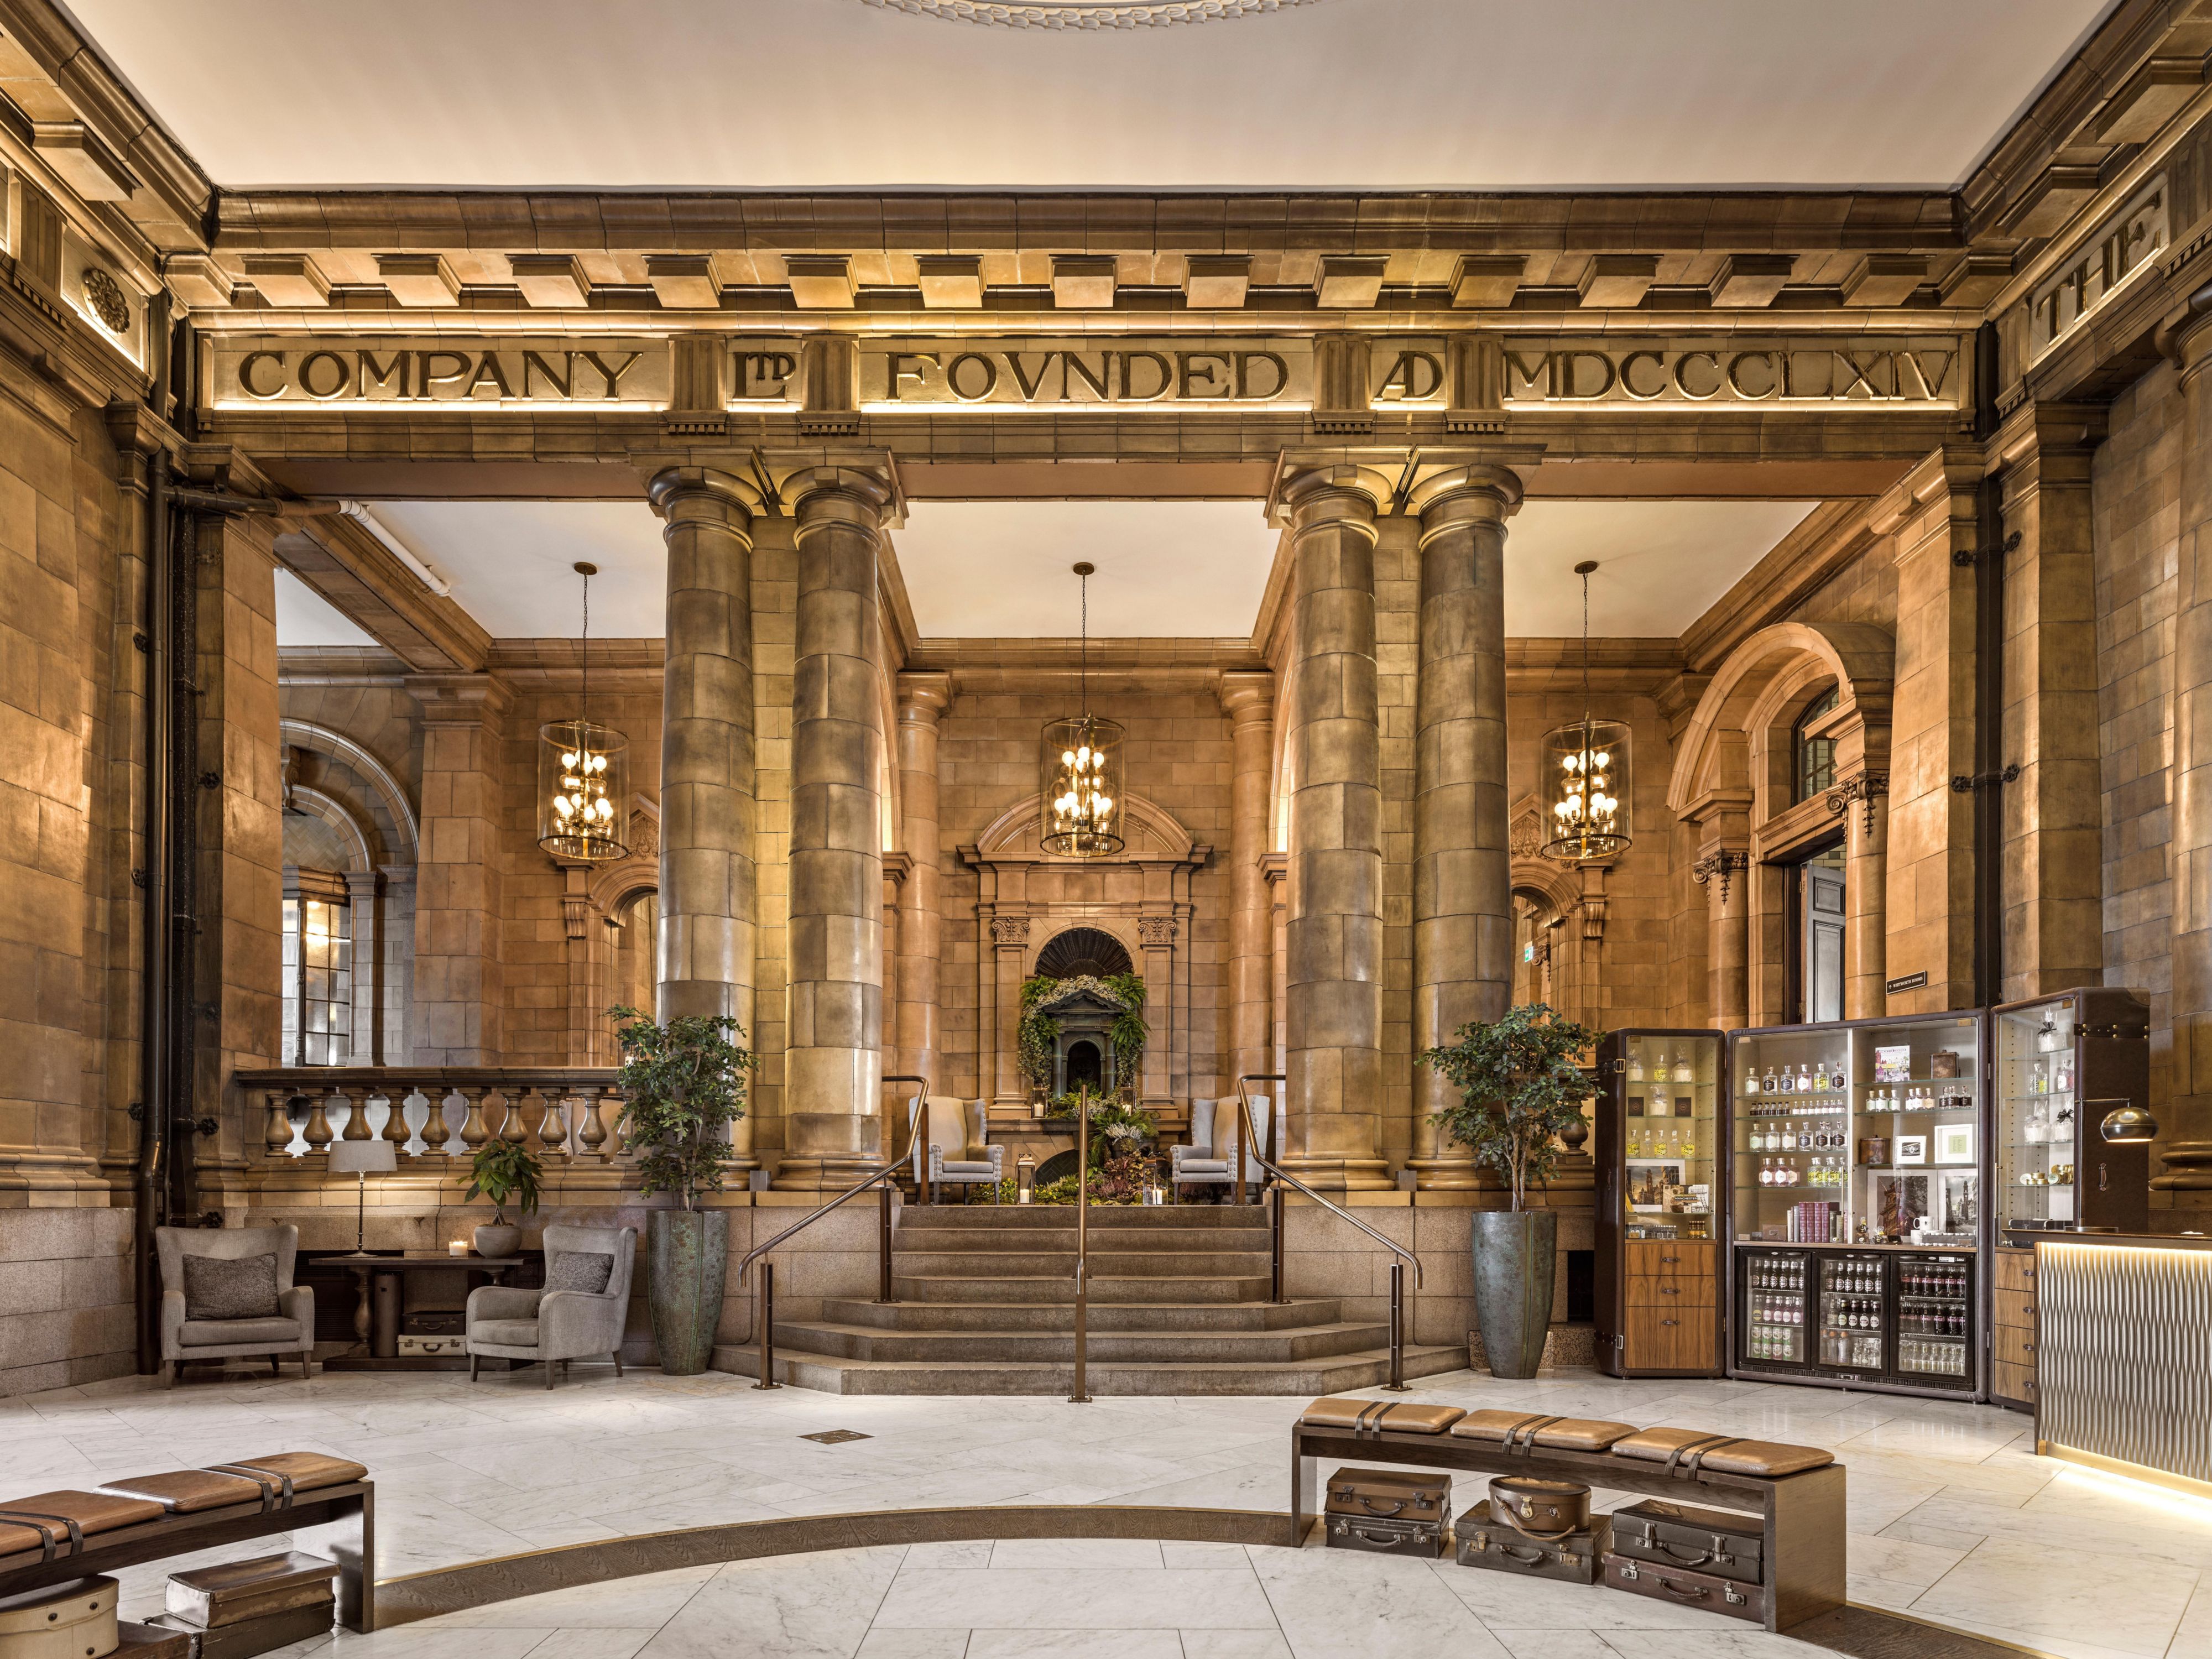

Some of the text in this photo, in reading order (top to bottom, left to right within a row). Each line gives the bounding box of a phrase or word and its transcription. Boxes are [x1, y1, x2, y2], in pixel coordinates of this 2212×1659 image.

[2036, 189, 2162, 346] THE
[237, 349, 1959, 402] COMPANY LTD FOVNDED AD MDCCCLXIV
[1893, 979, 1912, 988] WHITWORTH
